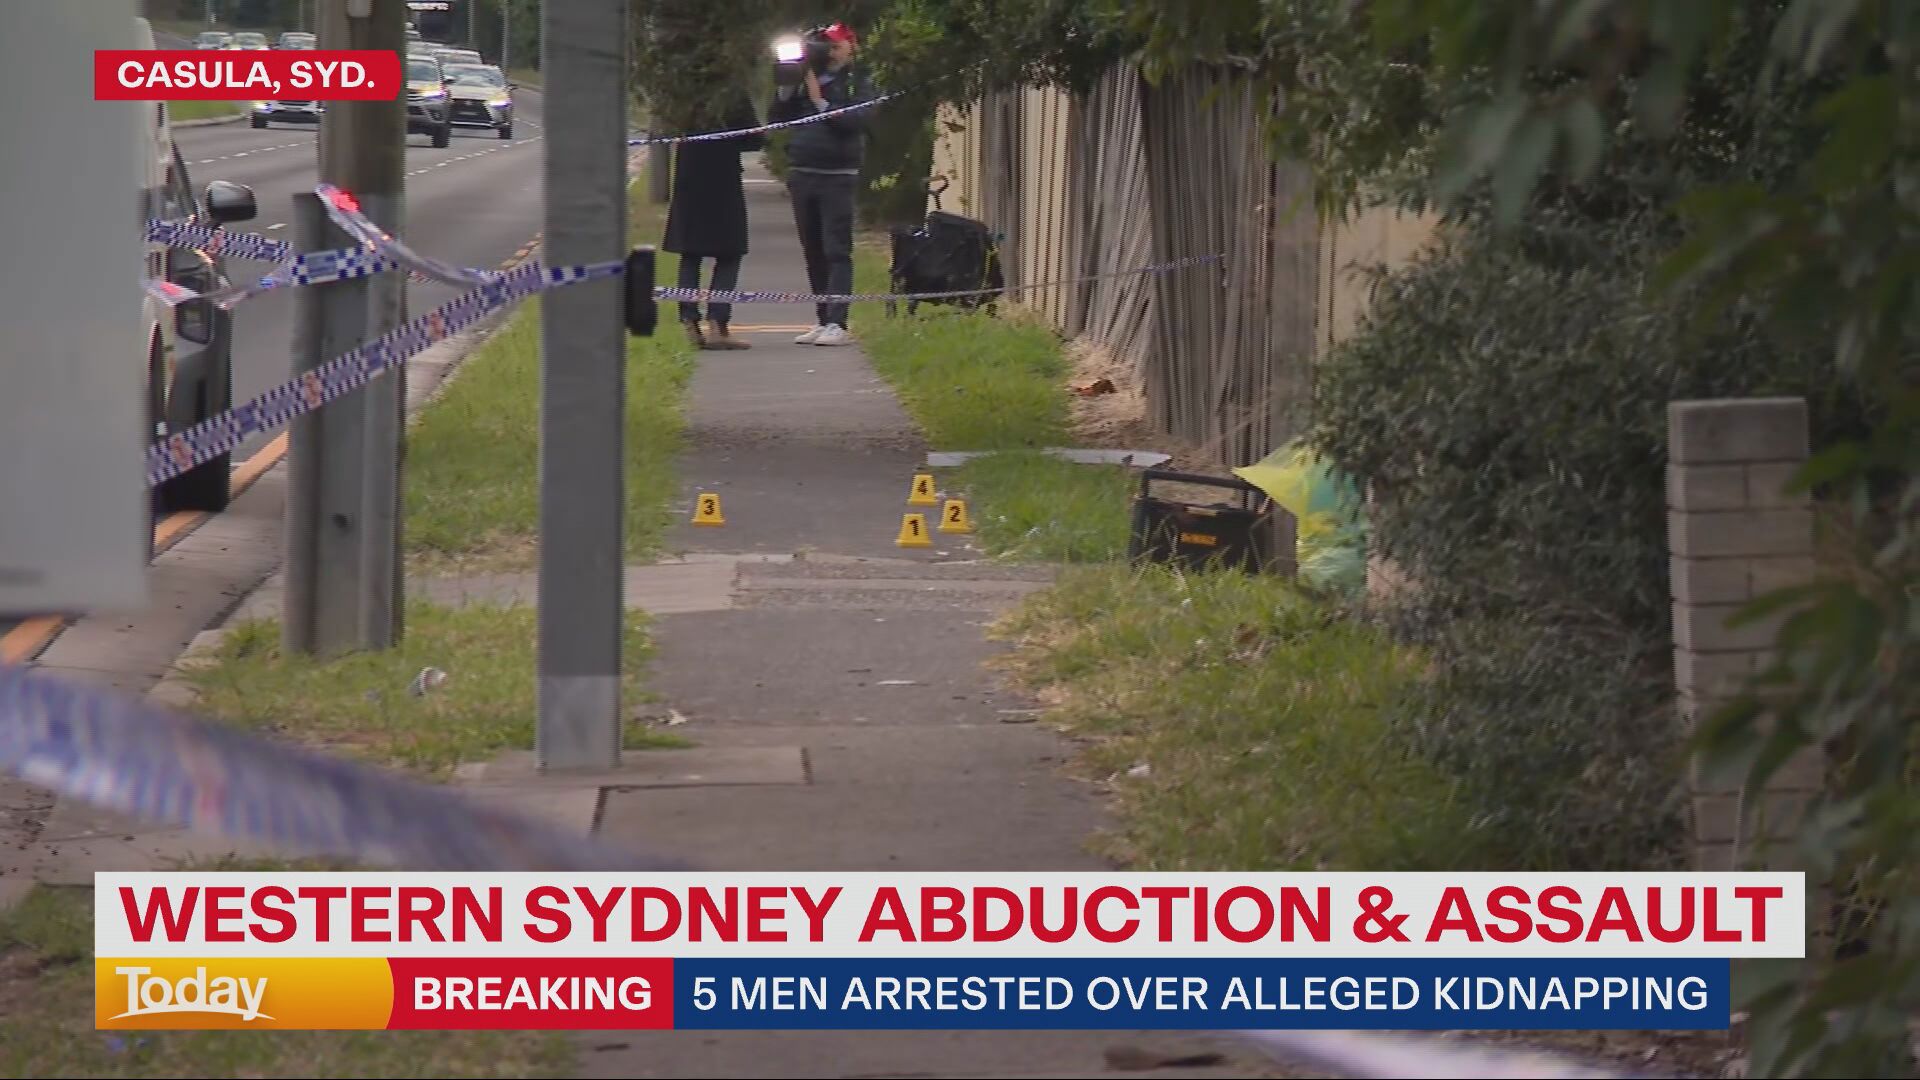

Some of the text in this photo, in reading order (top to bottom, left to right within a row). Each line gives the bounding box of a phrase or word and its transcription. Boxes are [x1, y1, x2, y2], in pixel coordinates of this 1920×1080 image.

[918, 479, 928, 496] 4
[703, 498, 715, 516] 3
[949, 505, 961, 523] 2
[908, 519, 919, 537] 1
